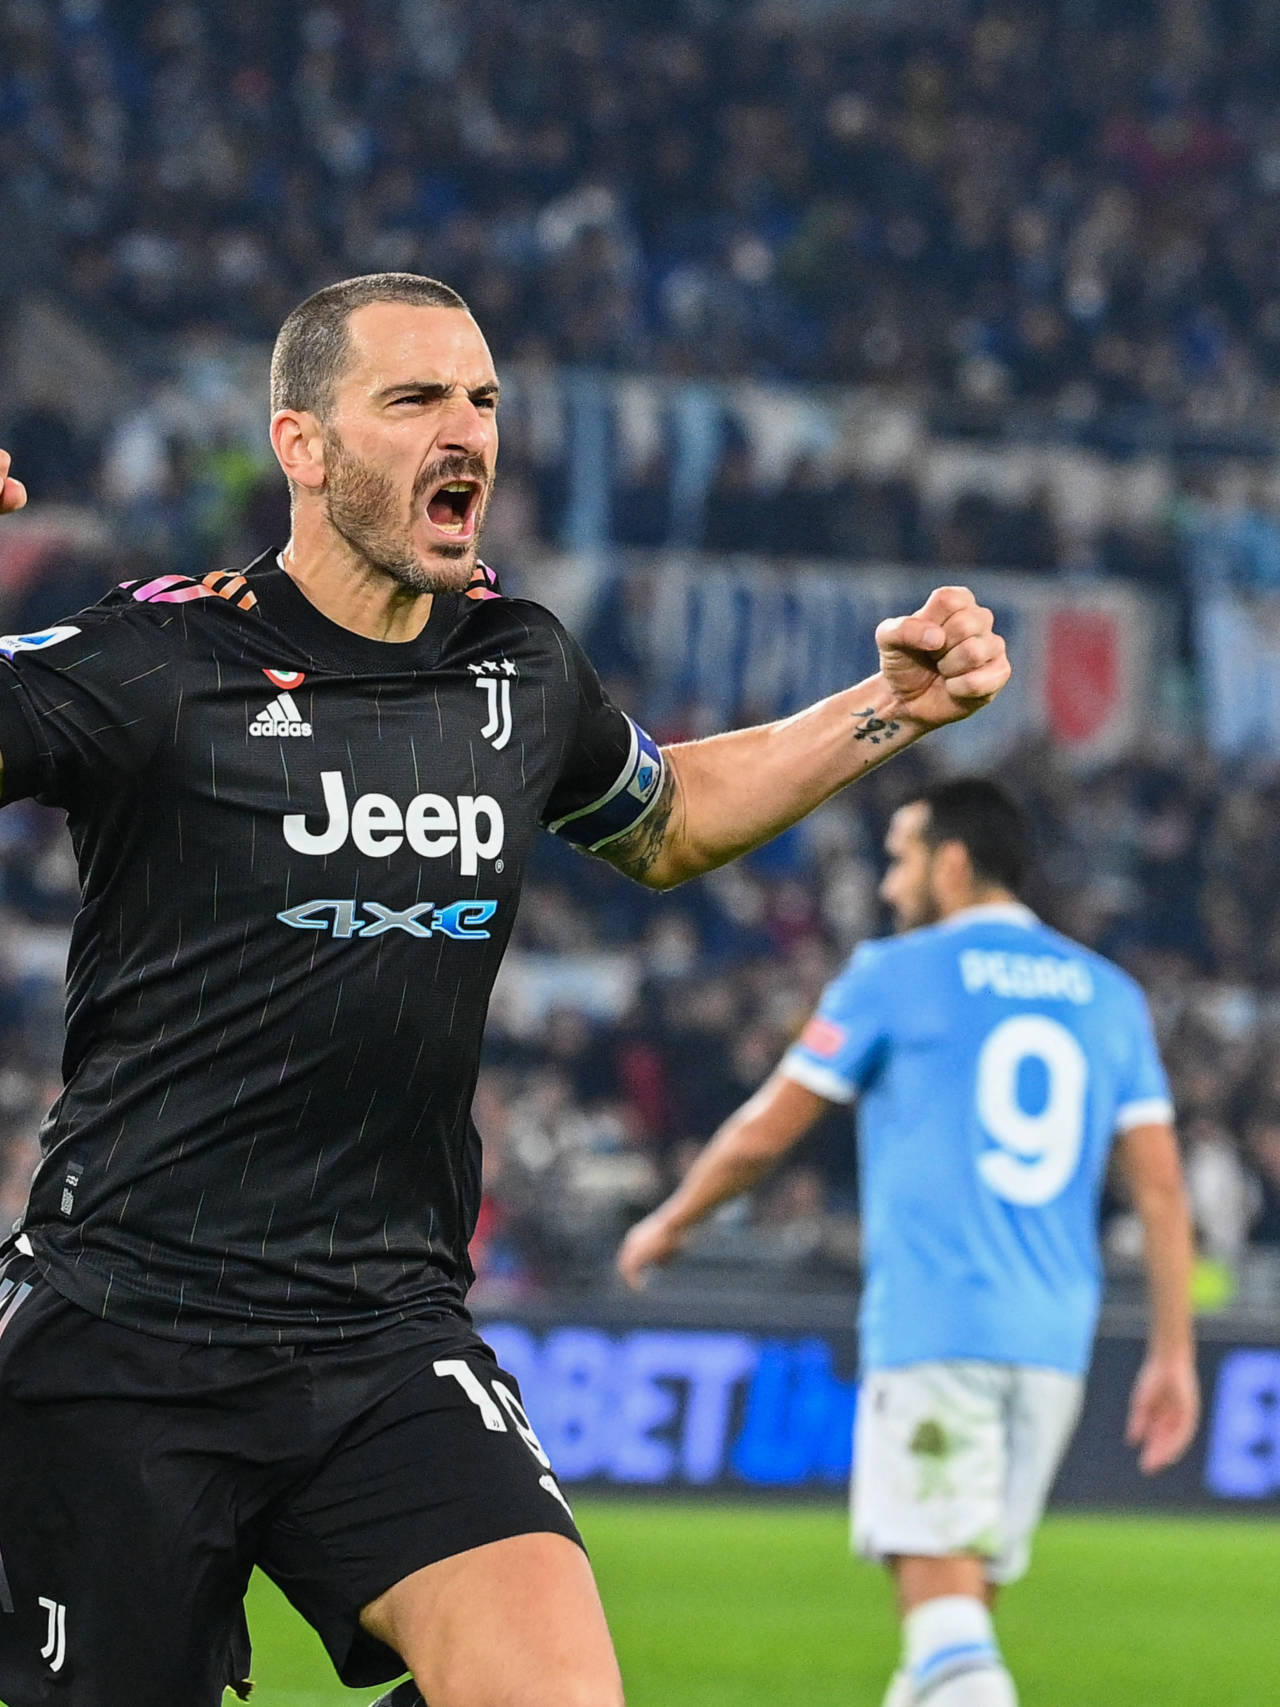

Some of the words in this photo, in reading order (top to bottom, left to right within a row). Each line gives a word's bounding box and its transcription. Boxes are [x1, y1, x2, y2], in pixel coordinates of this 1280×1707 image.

[249, 719, 312, 737] adidas
[283, 771, 504, 876] Jeep
[977, 1014, 1088, 1206] 9
[433, 1360, 551, 1469] 19
